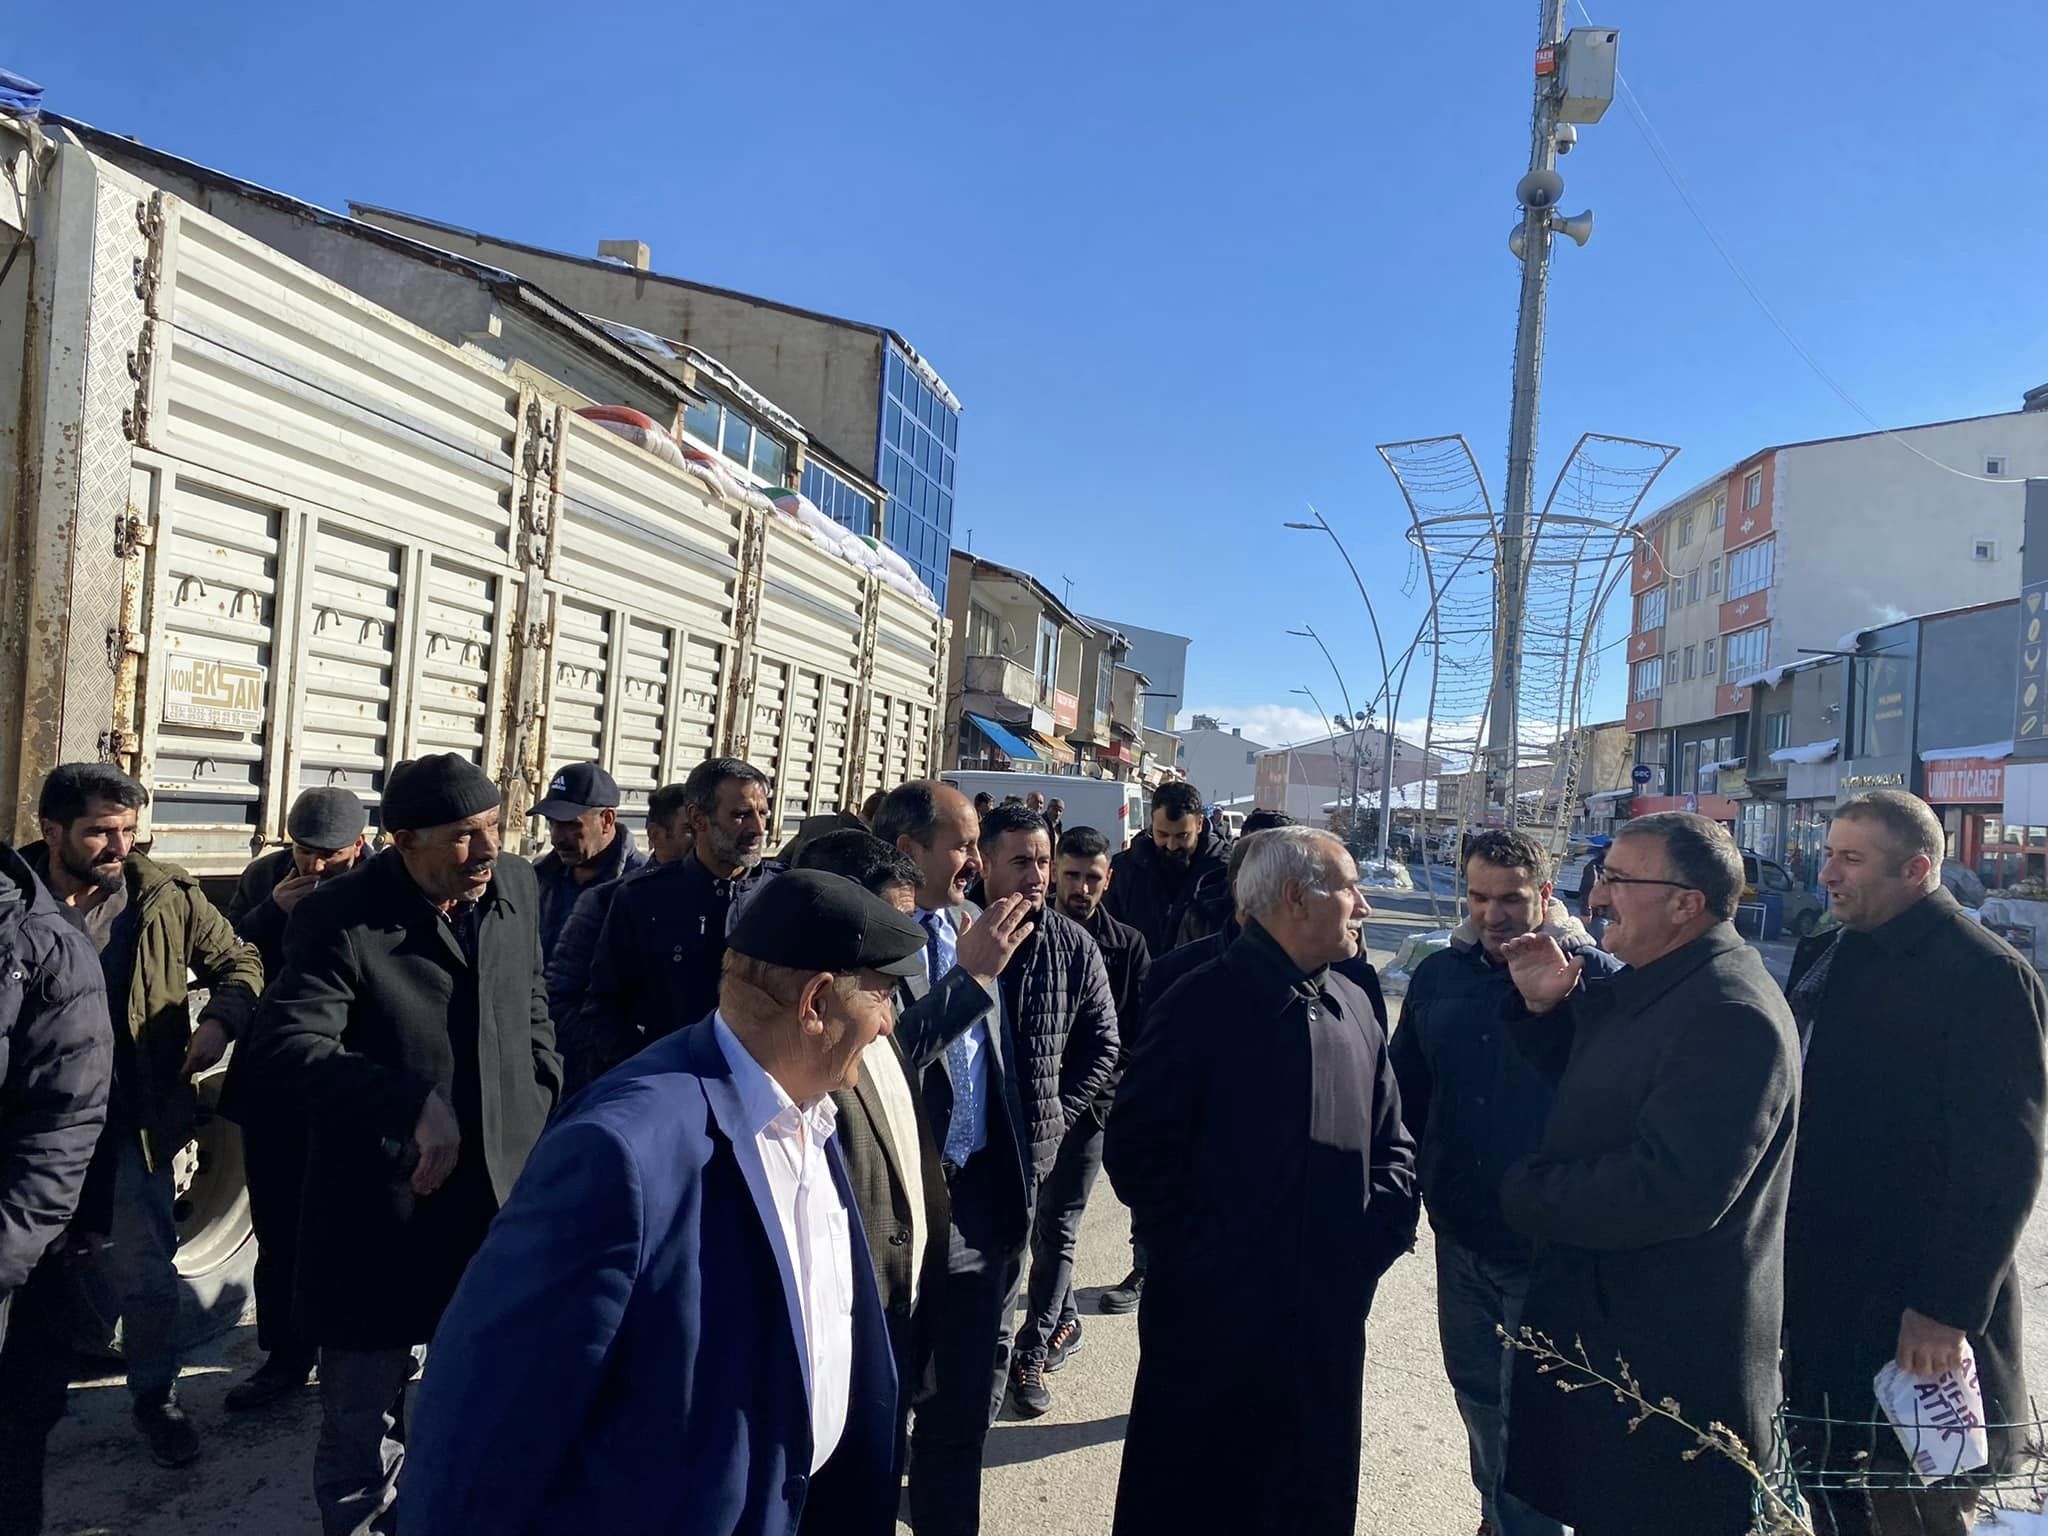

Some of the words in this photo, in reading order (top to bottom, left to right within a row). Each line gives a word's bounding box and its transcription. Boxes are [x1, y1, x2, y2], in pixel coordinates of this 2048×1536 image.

[170, 661, 260, 711] KONEKSAN
[1928, 770, 1955, 798] UMUT
[1913, 1383, 1964, 1442] ATIK
